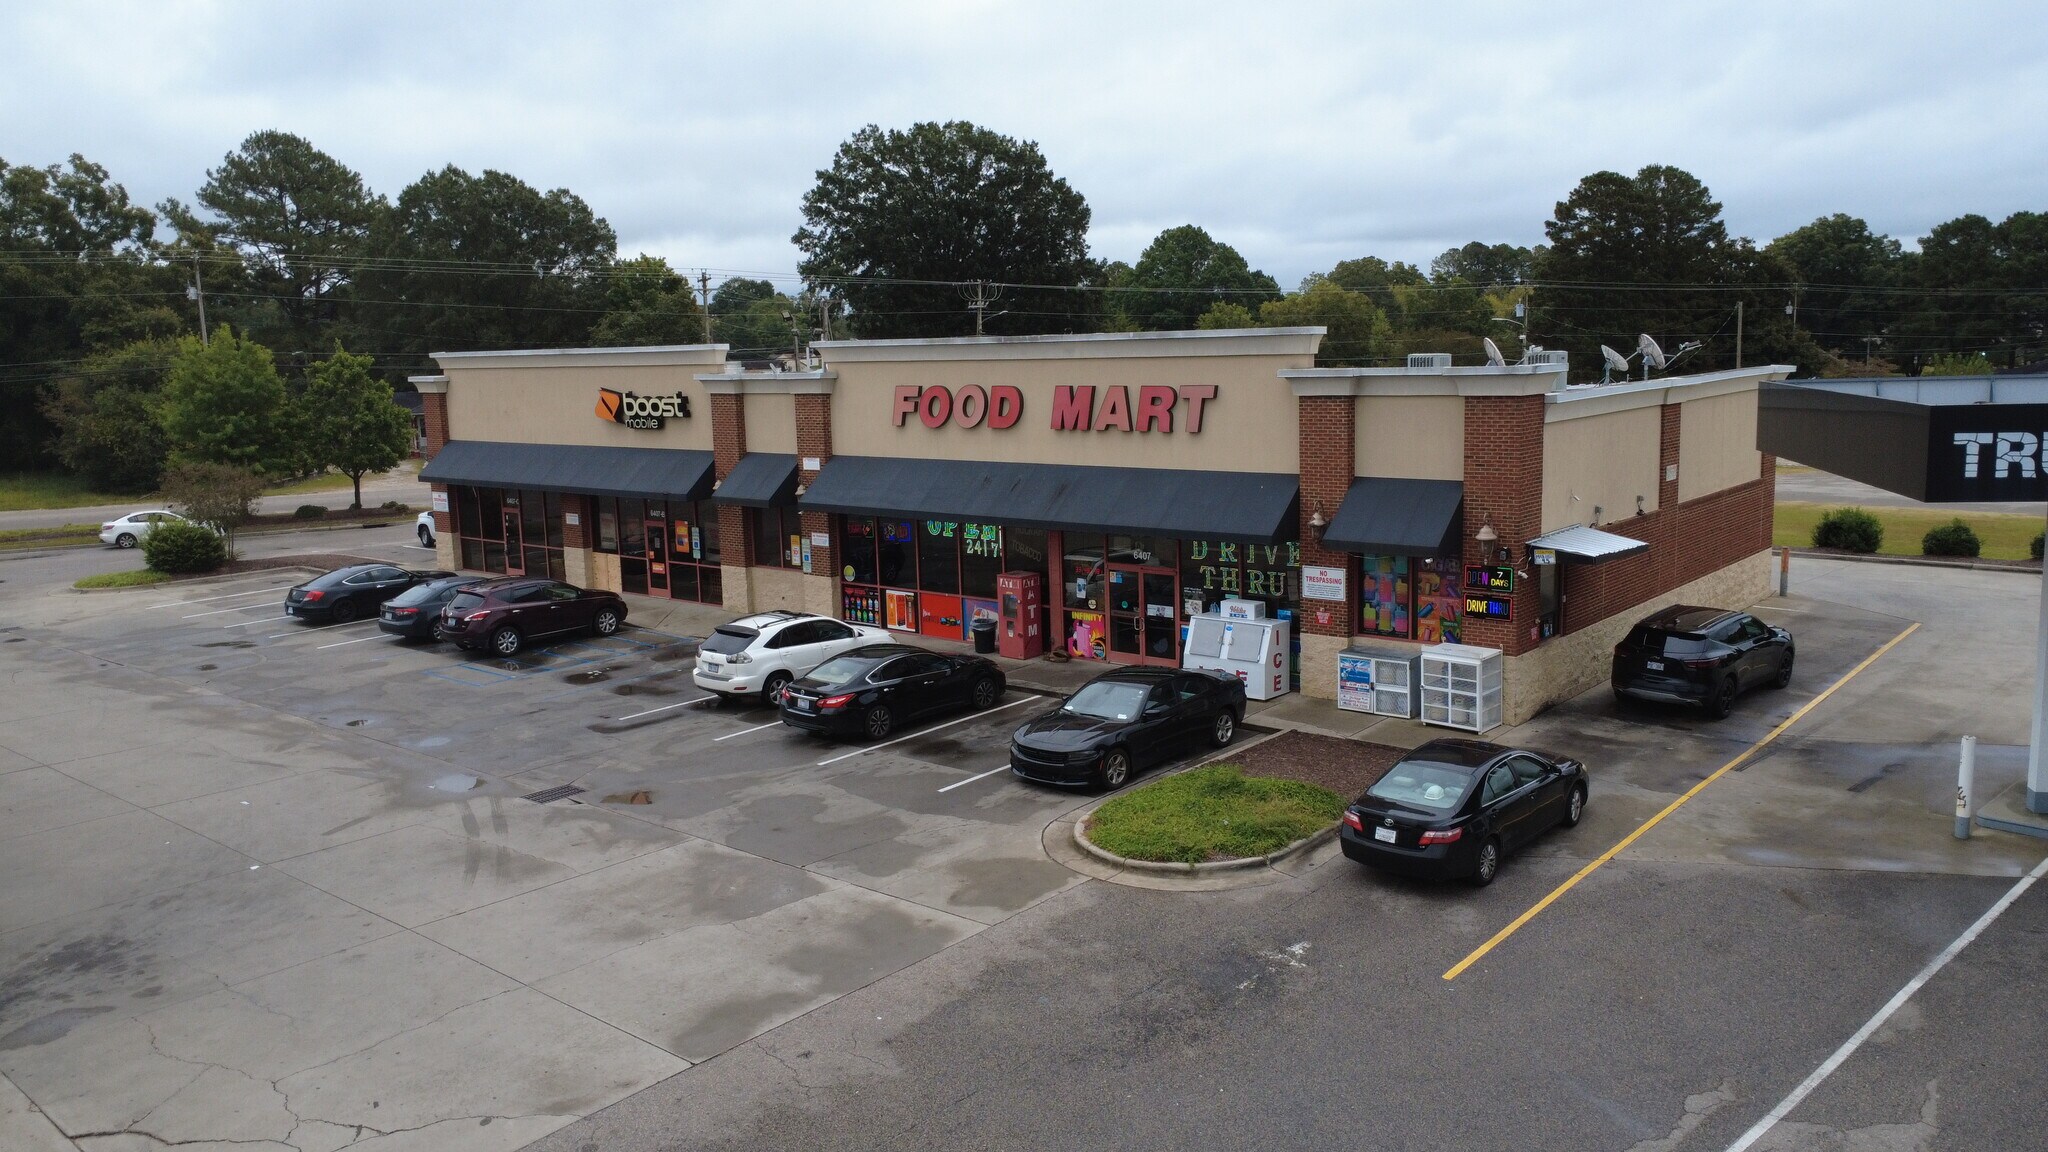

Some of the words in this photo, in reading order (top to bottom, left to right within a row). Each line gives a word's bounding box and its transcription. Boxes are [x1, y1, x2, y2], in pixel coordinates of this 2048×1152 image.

[622, 392, 684, 417] boost
[892, 384, 1024, 429] FOOD
[1050, 384, 1219, 433] MART
[625, 417, 659, 429] mobile
[1953, 431, 2048, 478] TR
[1133, 551, 1151, 560] 6407
[1191, 540, 1301, 567] DRIVE
[1200, 565, 1286, 597] THRU
[1305, 575, 1343, 585] TRESPASSING
[1467, 570, 1489, 585] OPEN
[1490, 578, 1509, 587] DAYS
[1027, 590, 1038, 637] ATM
[1071, 611, 1103, 622] INFINITY
[1466, 599, 1488, 613] DRIVE
[1489, 601, 1509, 616] THRU
[1273, 629, 1283, 693] ICE
